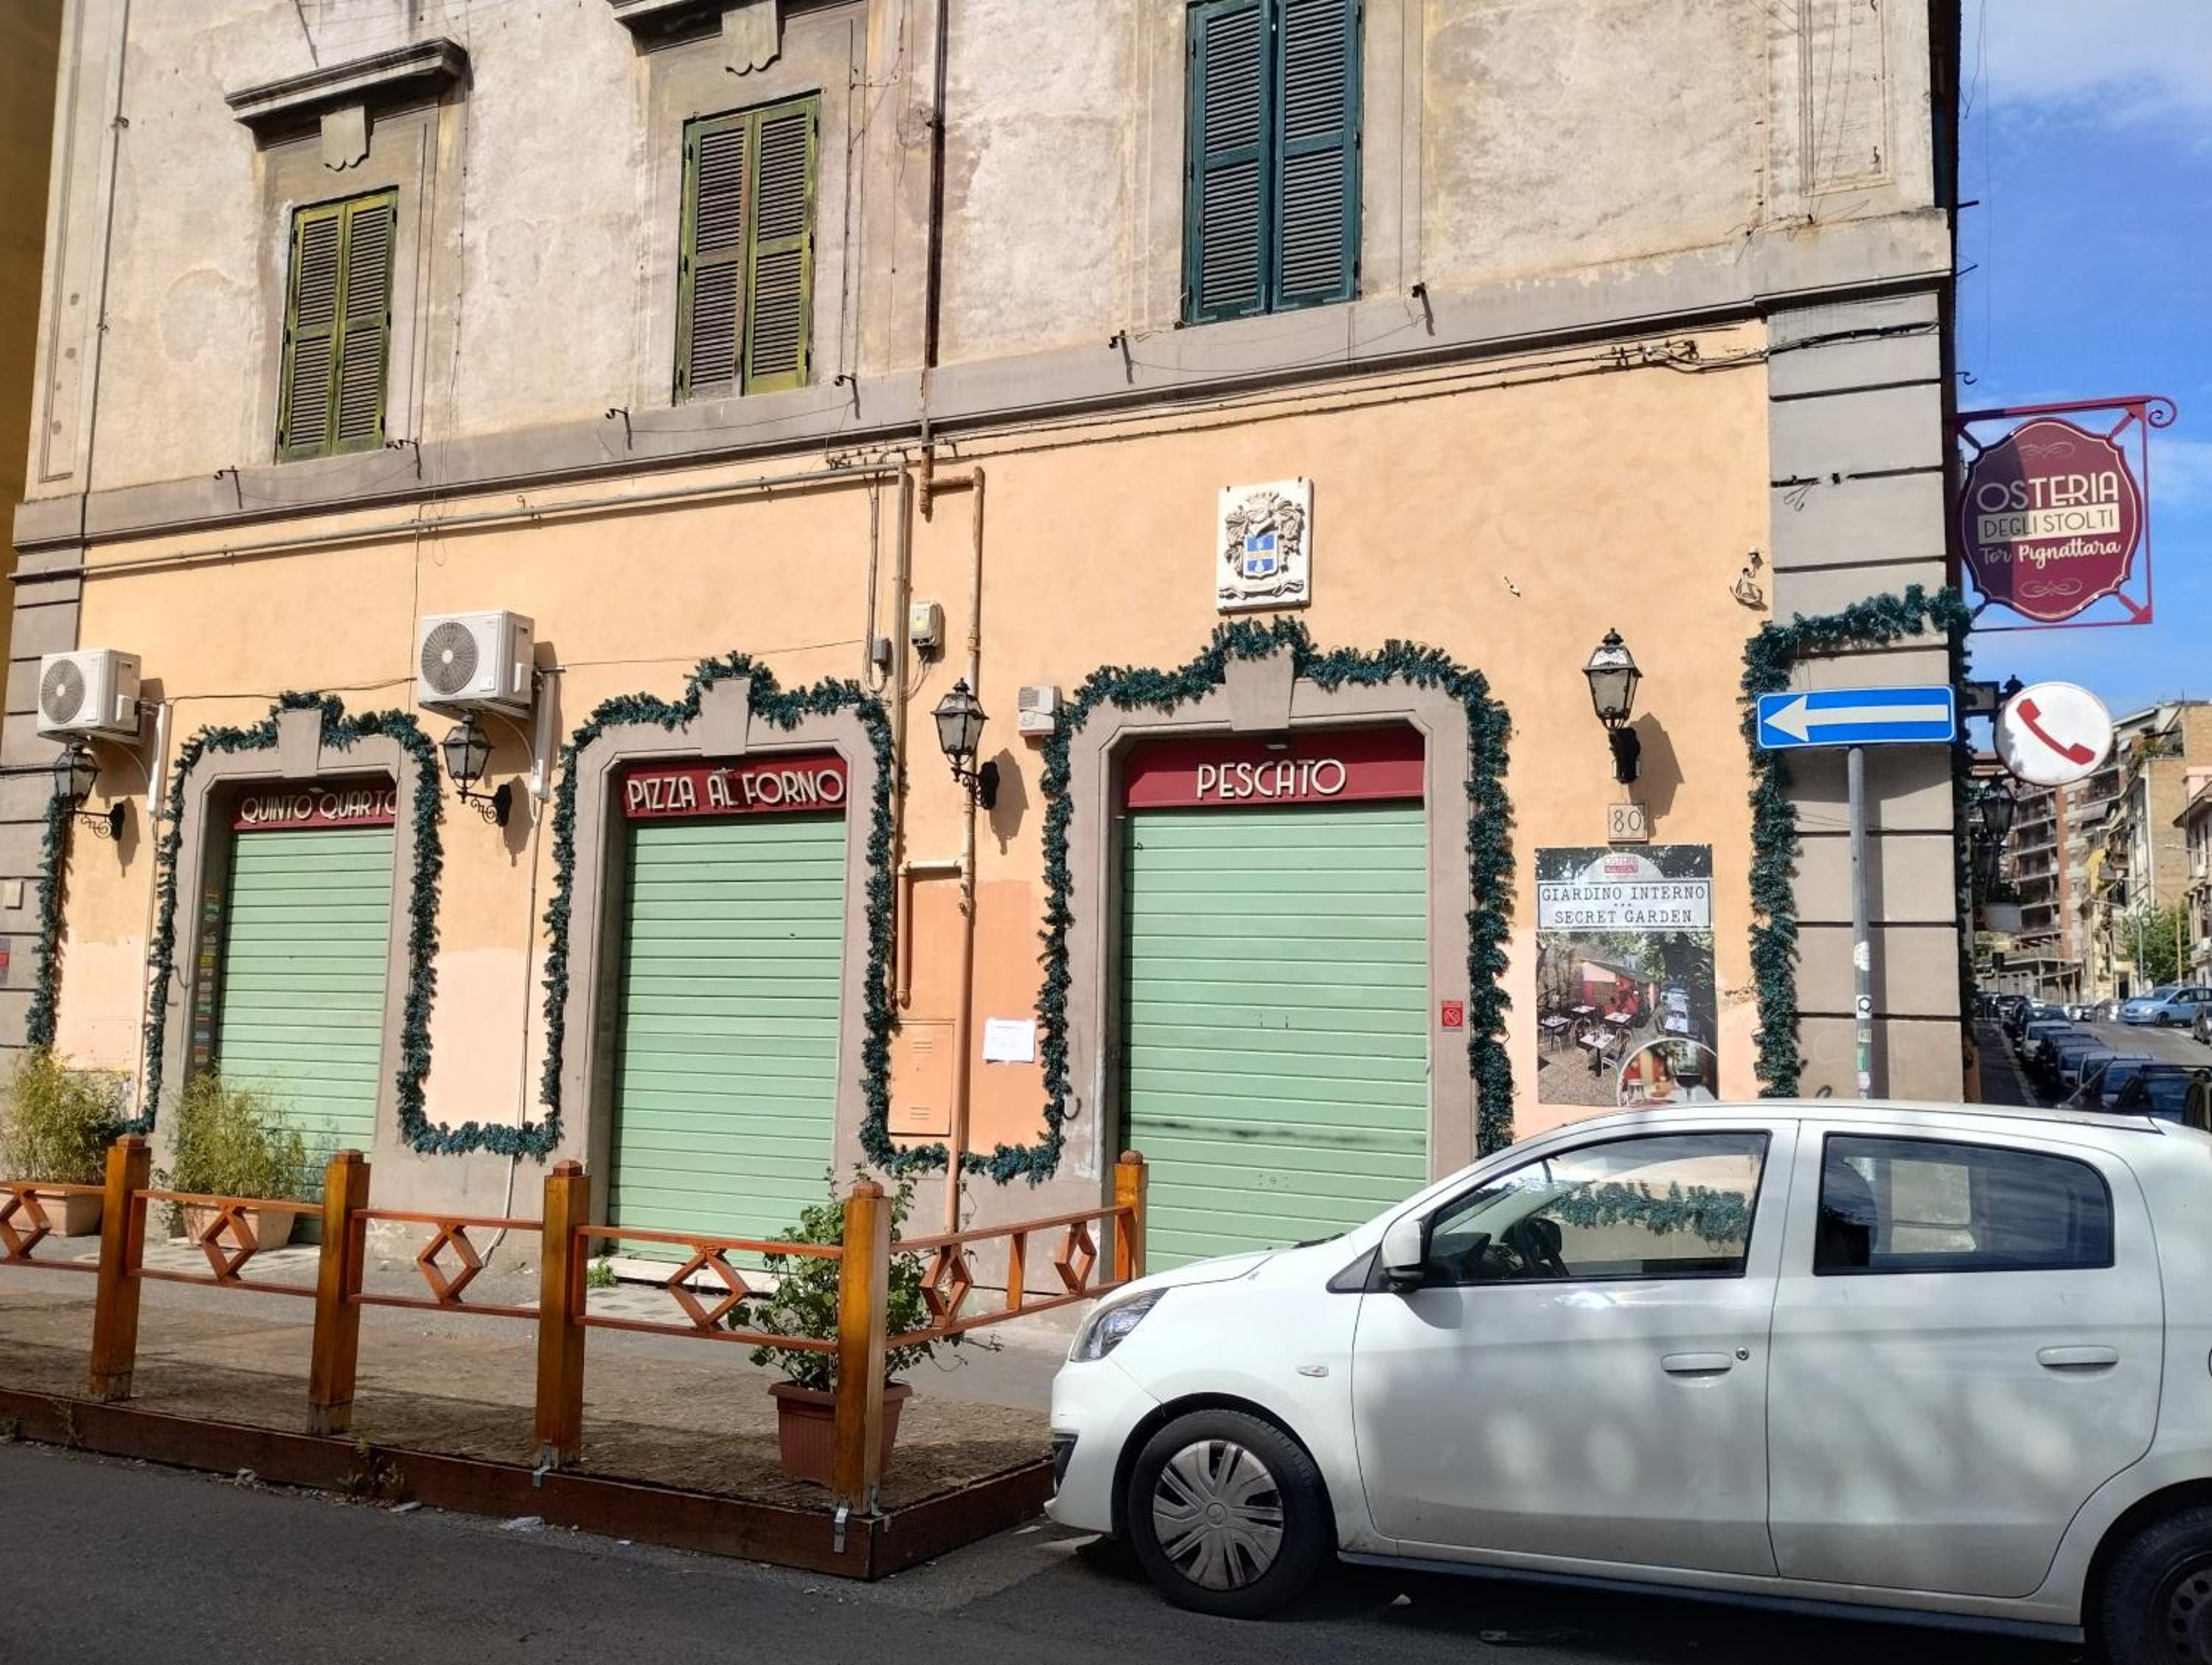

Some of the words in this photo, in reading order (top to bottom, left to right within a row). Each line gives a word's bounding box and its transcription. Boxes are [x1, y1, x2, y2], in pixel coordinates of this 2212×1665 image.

[1977, 471, 2119, 512] OSTERIA
[1984, 517, 2037, 538] DEGLI
[2043, 508, 2115, 533] STOLTI
[1979, 547, 2012, 565] Tor
[2017, 538, 2121, 569] Pignattara
[627, 776, 697, 810] PIZZA
[707, 775, 739, 806] AL
[742, 769, 844, 804] FORNO
[1197, 758, 1346, 799] PESCATO
[240, 793, 313, 824] QUINTO
[1613, 809, 1642, 832] 80
[1542, 886, 1622, 901] GIARDINO
[1630, 885, 1705, 900] INTERNO
[1555, 911, 1617, 924] SECRET
[1624, 909, 1692, 922] GARDEN
